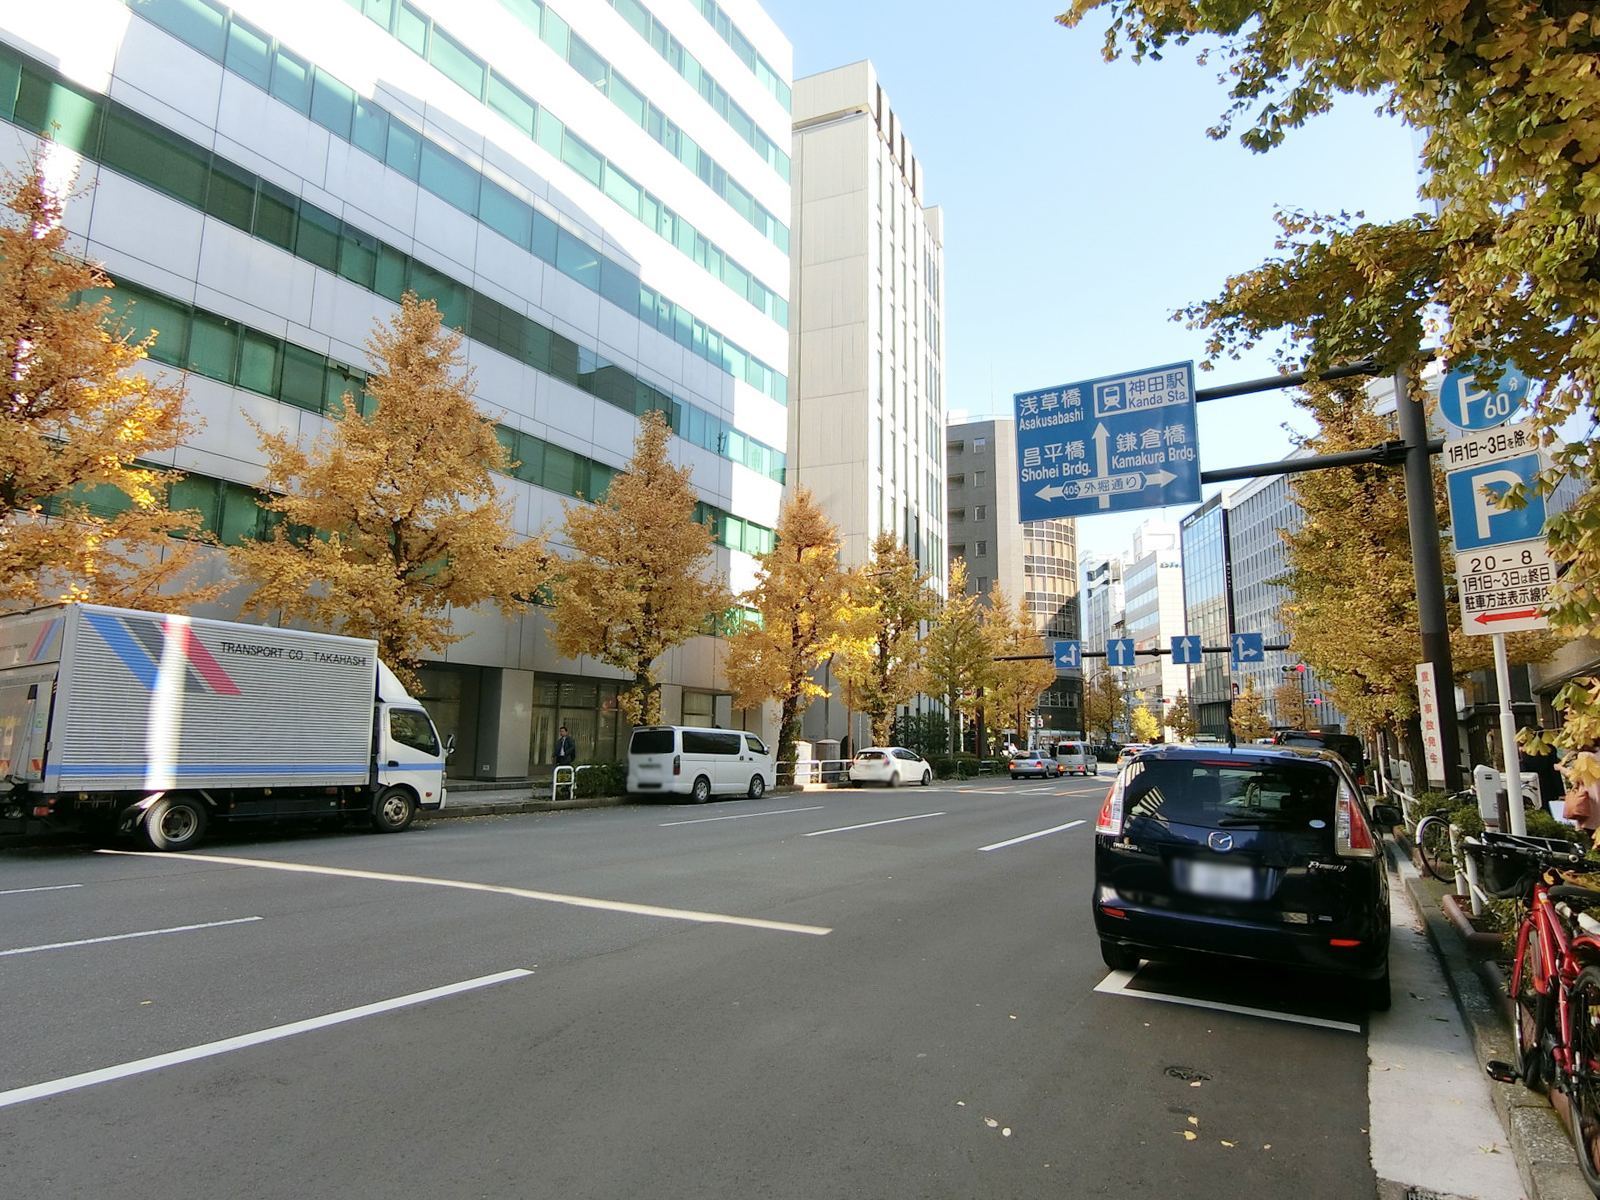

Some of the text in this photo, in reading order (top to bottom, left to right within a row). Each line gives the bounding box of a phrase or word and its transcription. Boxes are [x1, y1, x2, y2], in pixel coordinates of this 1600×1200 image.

[1128, 371, 1186, 396] 神田駅
[1508, 377, 1518, 392] 分
[1019, 388, 1082, 417] 浅草橋
[1128, 391, 1188, 410] Kanda Sta.
[1484, 393, 1510, 419] 60
[1019, 407, 1084, 431] Asakusabashi
[1116, 424, 1186, 453] 鎌倉橋
[1023, 440, 1086, 467] 昌平橋
[1111, 446, 1196, 469] Kamakura Brdg.
[1021, 461, 1091, 483] Shohei Brdg.
[1063, 476, 1137, 496] 405 外堀通り
[1471, 469, 1525, 540] P
[220, 641, 284, 658] TRANSPORT
[313, 652, 367, 667] TAKAHASHI
